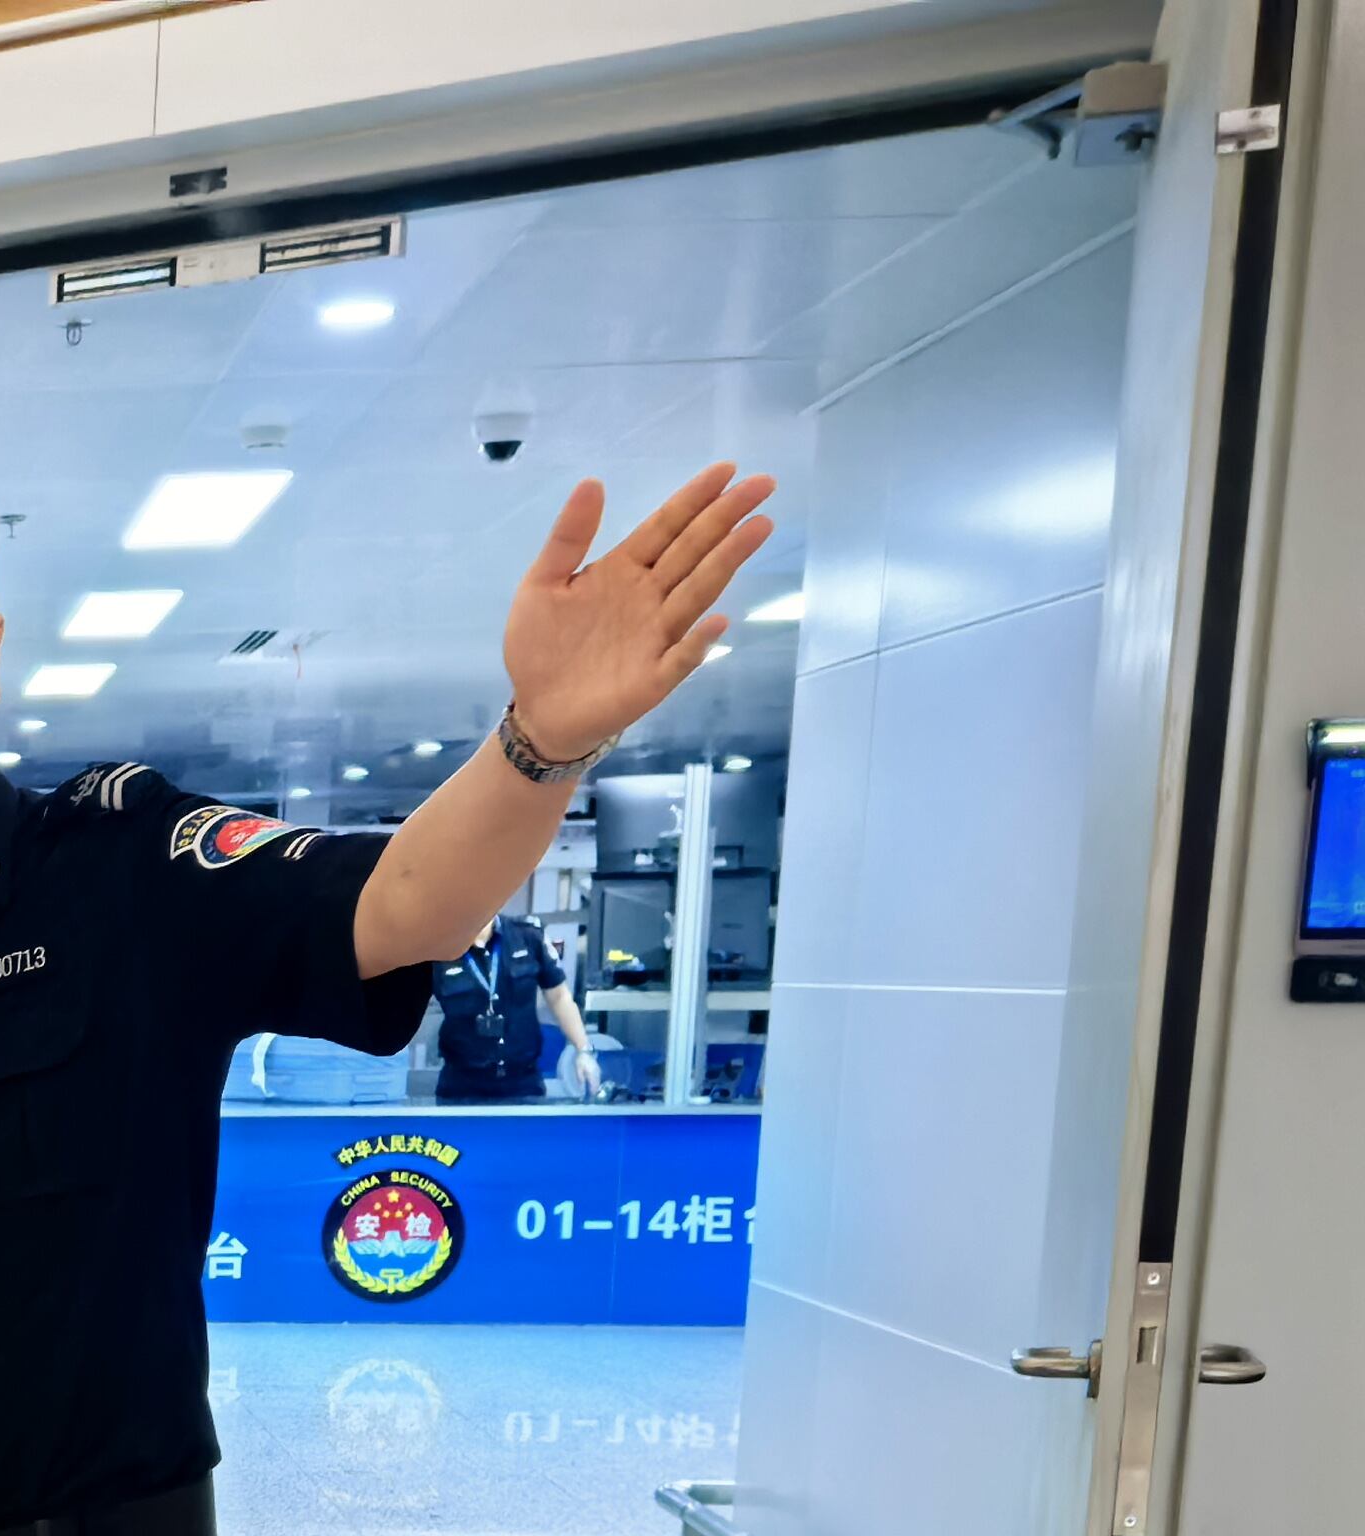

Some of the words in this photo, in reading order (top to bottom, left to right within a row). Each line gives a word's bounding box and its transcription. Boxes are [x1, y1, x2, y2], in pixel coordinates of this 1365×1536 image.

[338, 1134, 460, 1168] 中华人民共和国
[341, 1175, 380, 1206] CHINA
[390, 1171, 453, 1208] SECURITY
[206, 1231, 249, 1280] 台
